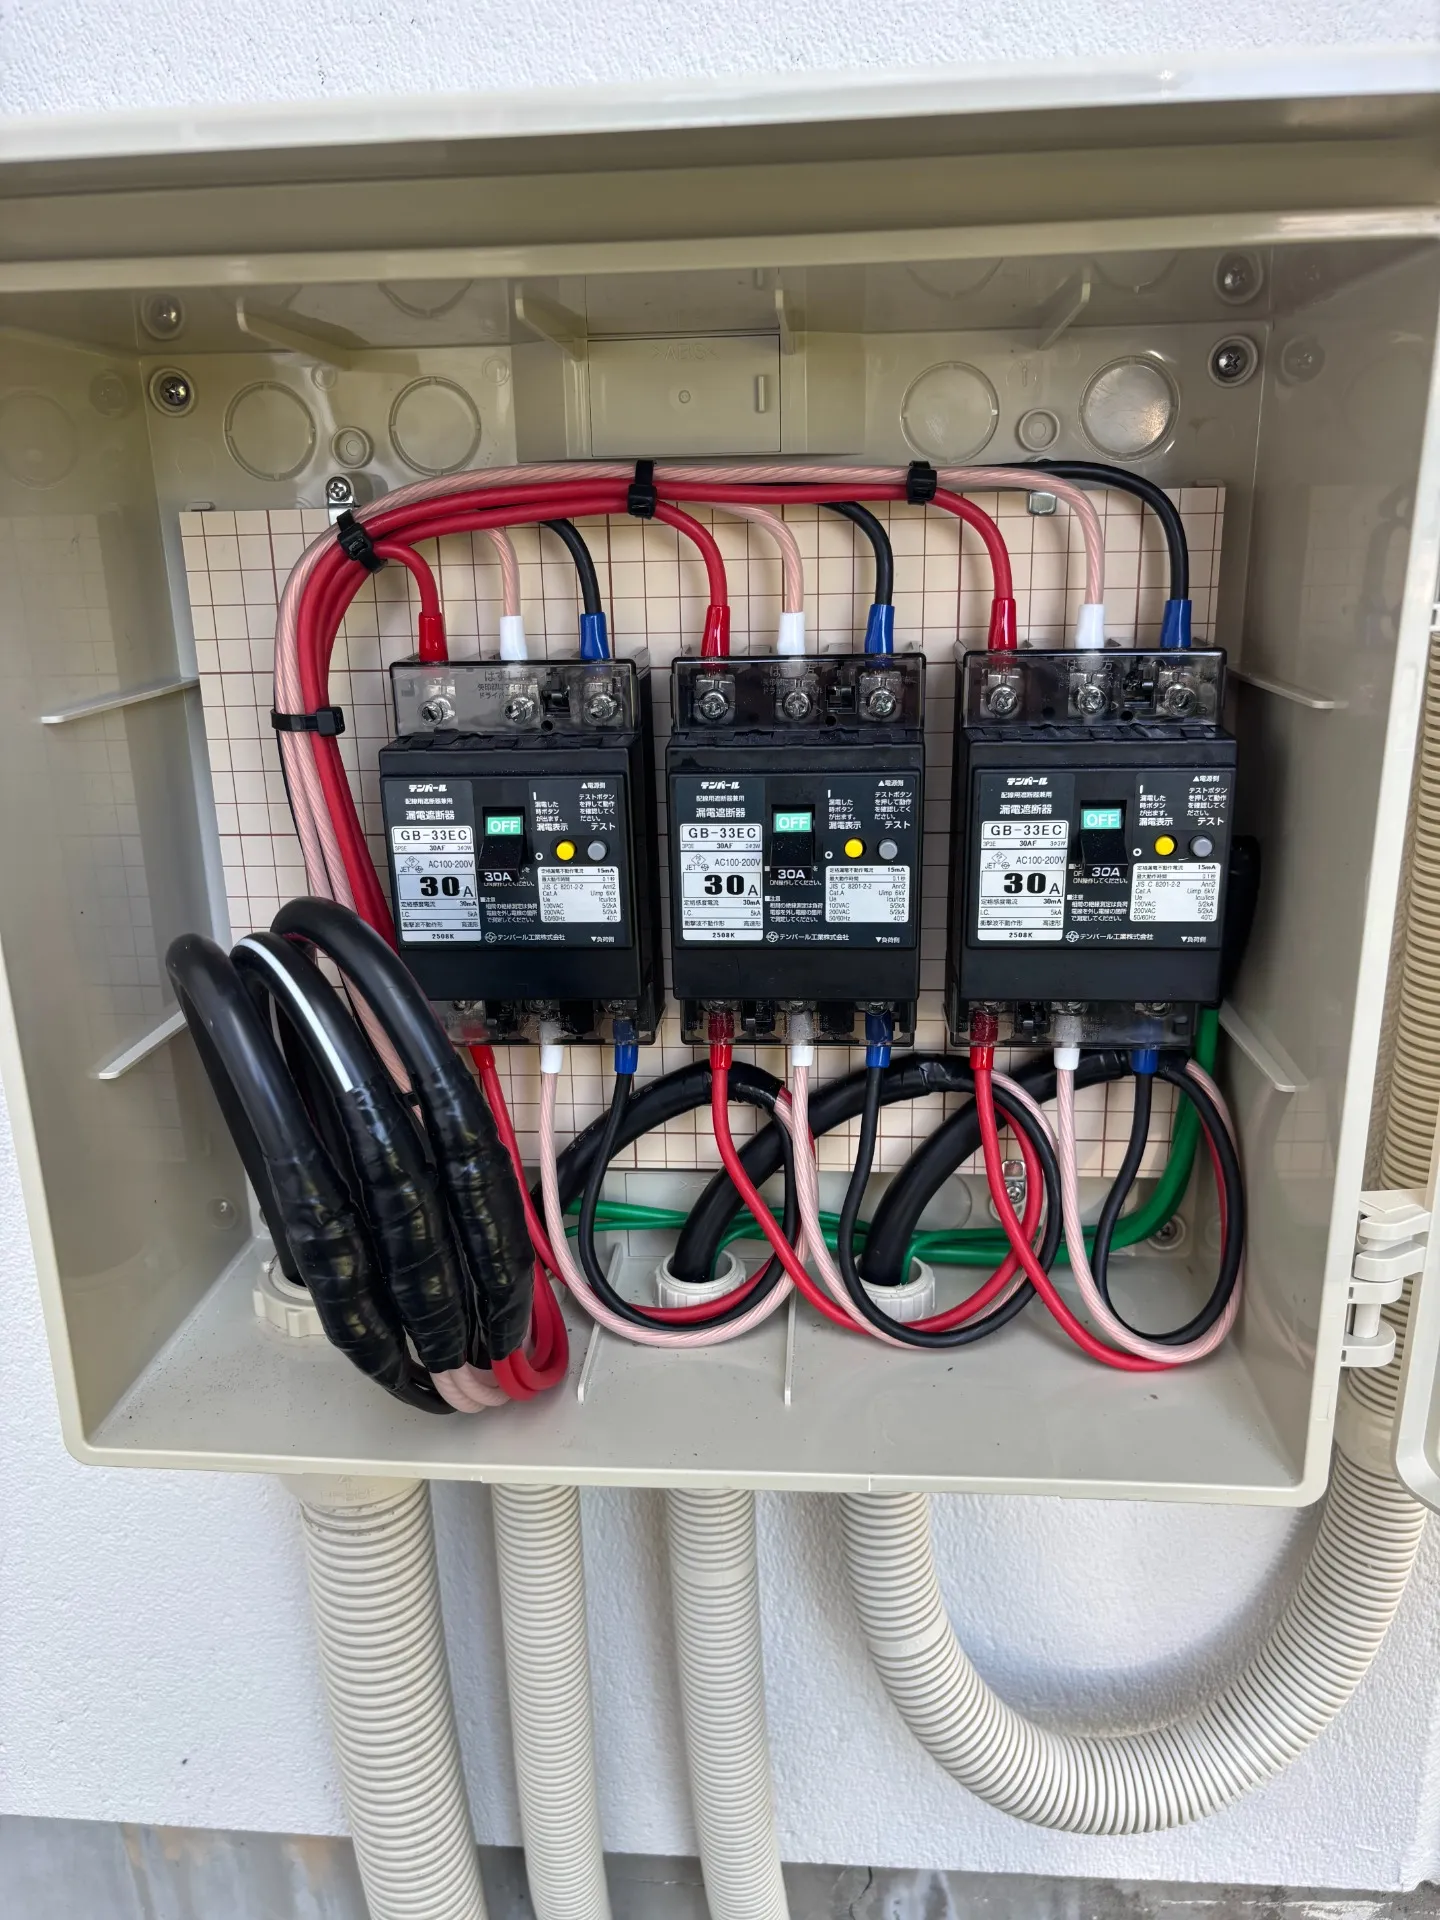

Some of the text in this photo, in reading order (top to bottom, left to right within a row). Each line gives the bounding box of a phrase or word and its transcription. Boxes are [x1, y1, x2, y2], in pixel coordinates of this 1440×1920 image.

[701, 781, 740, 789] テンパール
[1007, 777, 1048, 785] テンパール
[409, 784, 447, 792] テンパール
[696, 807, 746, 818] 漏電遮断器
[1000, 804, 1052, 814] 漏電遮断器
[406, 810, 455, 820] 漏電遮断器
[778, 816, 808, 829] OFF
[828, 821, 861, 830] 漏電表示
[884, 821, 911, 829] テスト
[1086, 814, 1117, 827] OFF
[1139, 817, 1173, 826] 漏電表示
[1197, 817, 1224, 826] テスト
[490, 820, 519, 832] OFF
[537, 823, 569, 831] 漏電表示
[591, 823, 616, 831] テスト
[991, 825, 1062, 836] GB-33EC
[401, 830, 467, 840] GB-33EC
[688, 828, 756, 838] GB-33EC
[1016, 856, 1066, 865] AC100-200V
[777, 869, 806, 879] 30A
[1091, 867, 1120, 877] 30A
